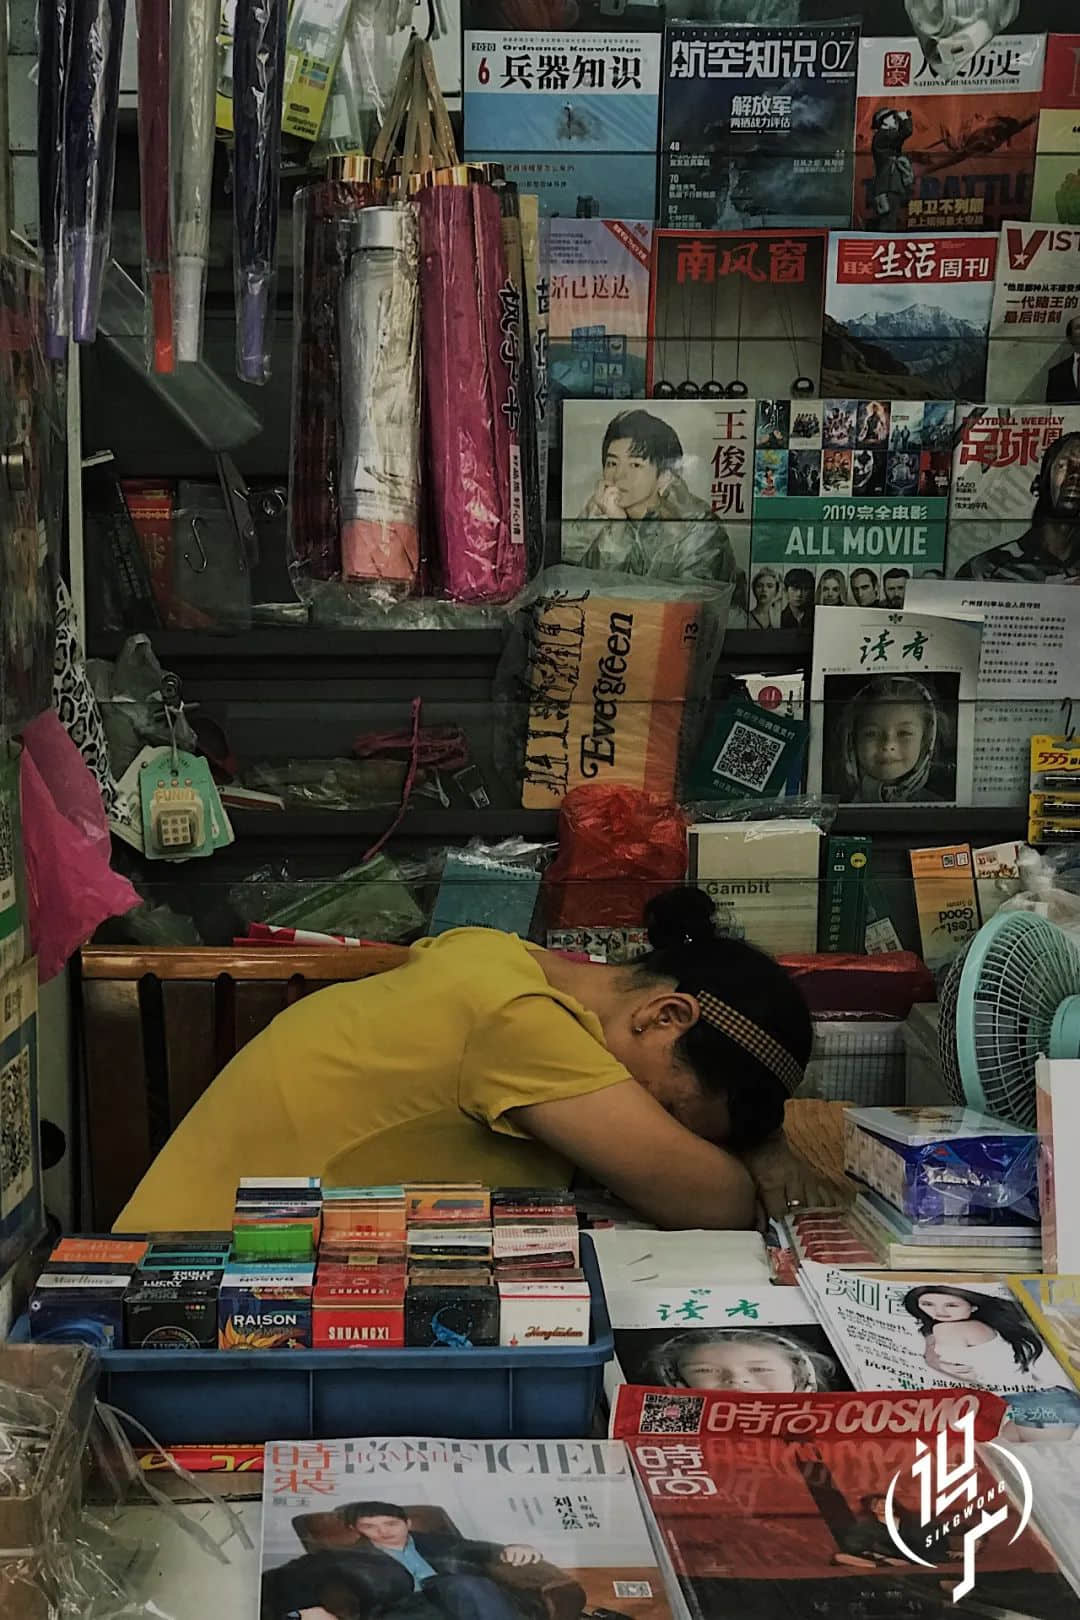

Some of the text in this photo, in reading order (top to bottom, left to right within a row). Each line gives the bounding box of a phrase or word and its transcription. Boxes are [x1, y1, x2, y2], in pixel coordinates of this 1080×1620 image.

[669, 40, 817, 79] 航空知识
[821, 41, 856, 71] 07
[914, 50, 1020, 79] 人历史
[478, 57, 490, 84] 6
[499, 54, 642, 89] 兵器知识
[731, 95, 792, 116] 解放军
[677, 240, 809, 284] 南风窗
[1003, 310, 1062, 323] 最后时刻
[711, 408, 749, 514] 王俊凯
[785, 526, 928, 556] ALL MOVIE
[859, 629, 929, 664] 读者
[581, 612, 633, 778] Evergreen
[1038, 752, 1069, 765] 555
[706, 881, 770, 895] Gambit
[939, 908, 974, 923] Good
[143, 1280, 183, 1288] LUCKY
[233, 1314, 297, 1328] RAISON
[656, 1299, 761, 1322] 读者
[328, 1326, 389, 1341] SHUANGXI
[834, 1394, 980, 1434] COSMO
